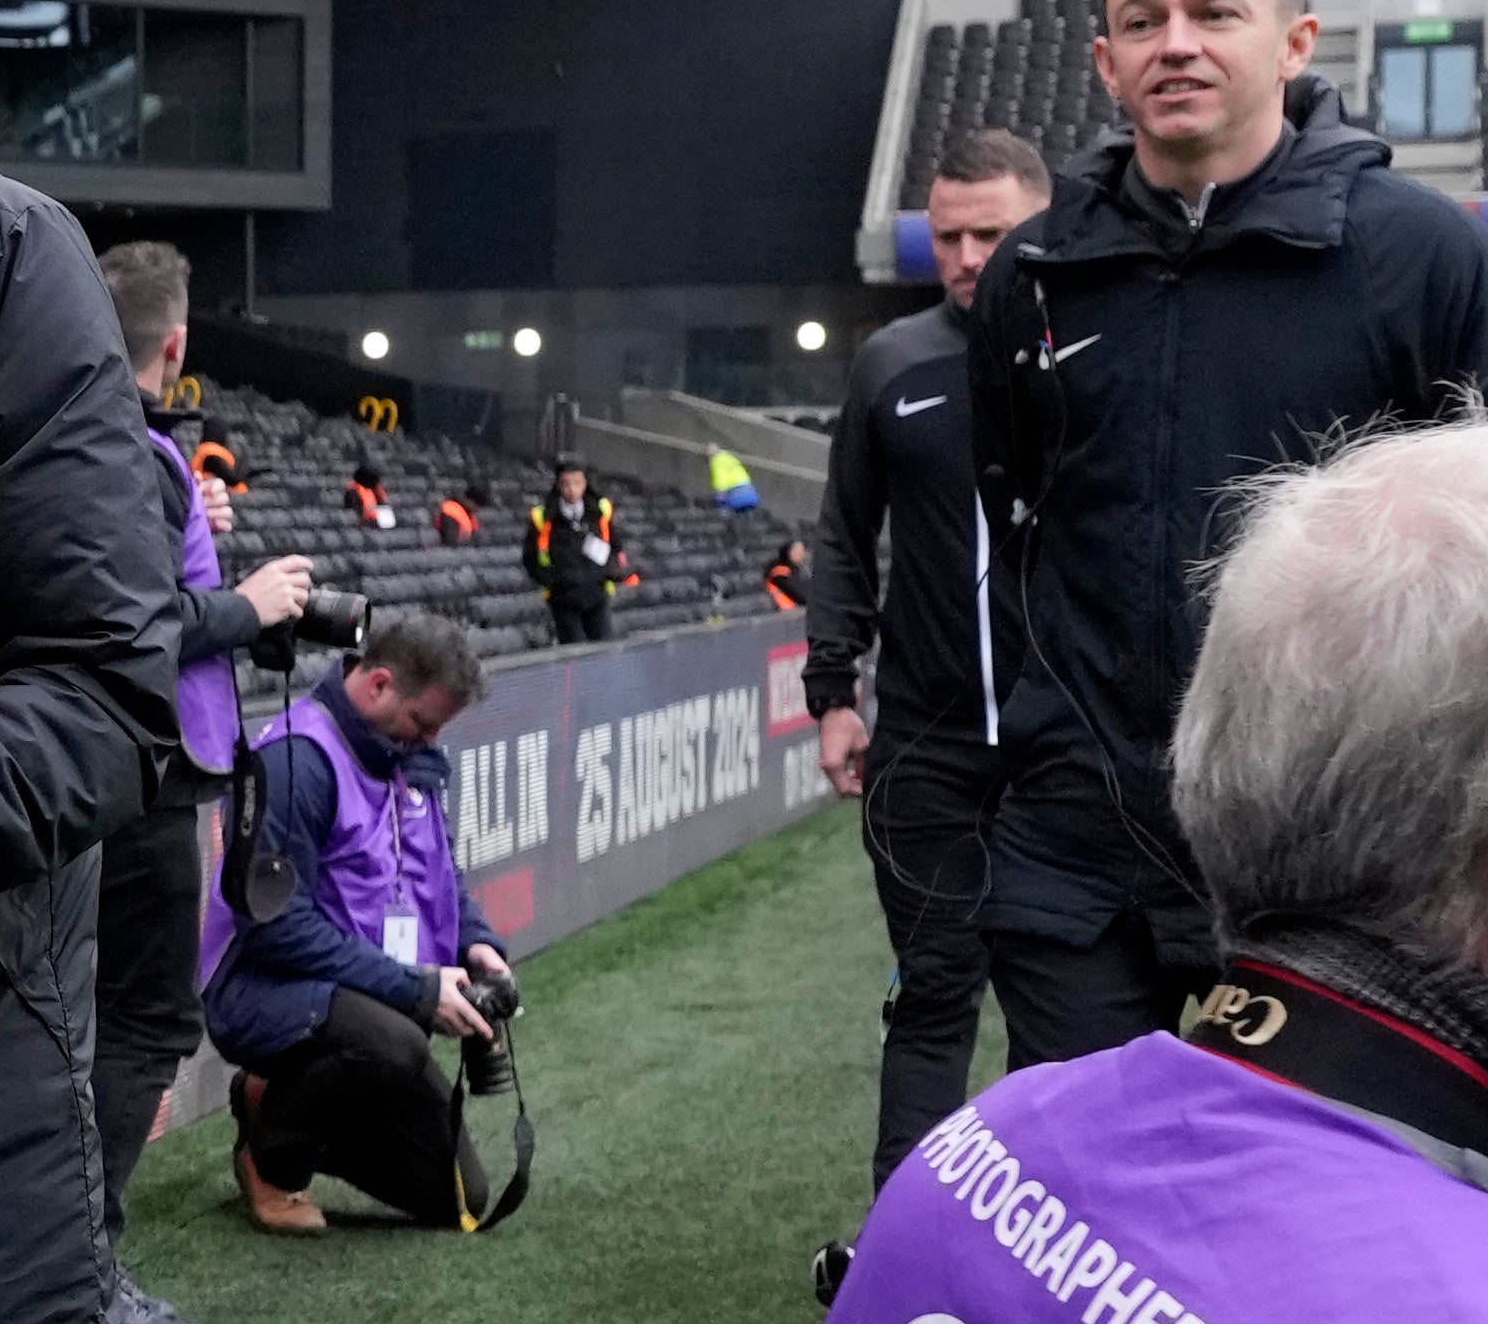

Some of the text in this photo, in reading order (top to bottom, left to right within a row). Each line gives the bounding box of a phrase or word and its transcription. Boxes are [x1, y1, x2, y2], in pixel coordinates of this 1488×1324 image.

[456, 741, 513, 873] ALL
[517, 729, 549, 852] IN
[576, 722, 613, 864] 25
[616, 693, 712, 847] AUGUST
[713, 685, 760, 805] 2024
